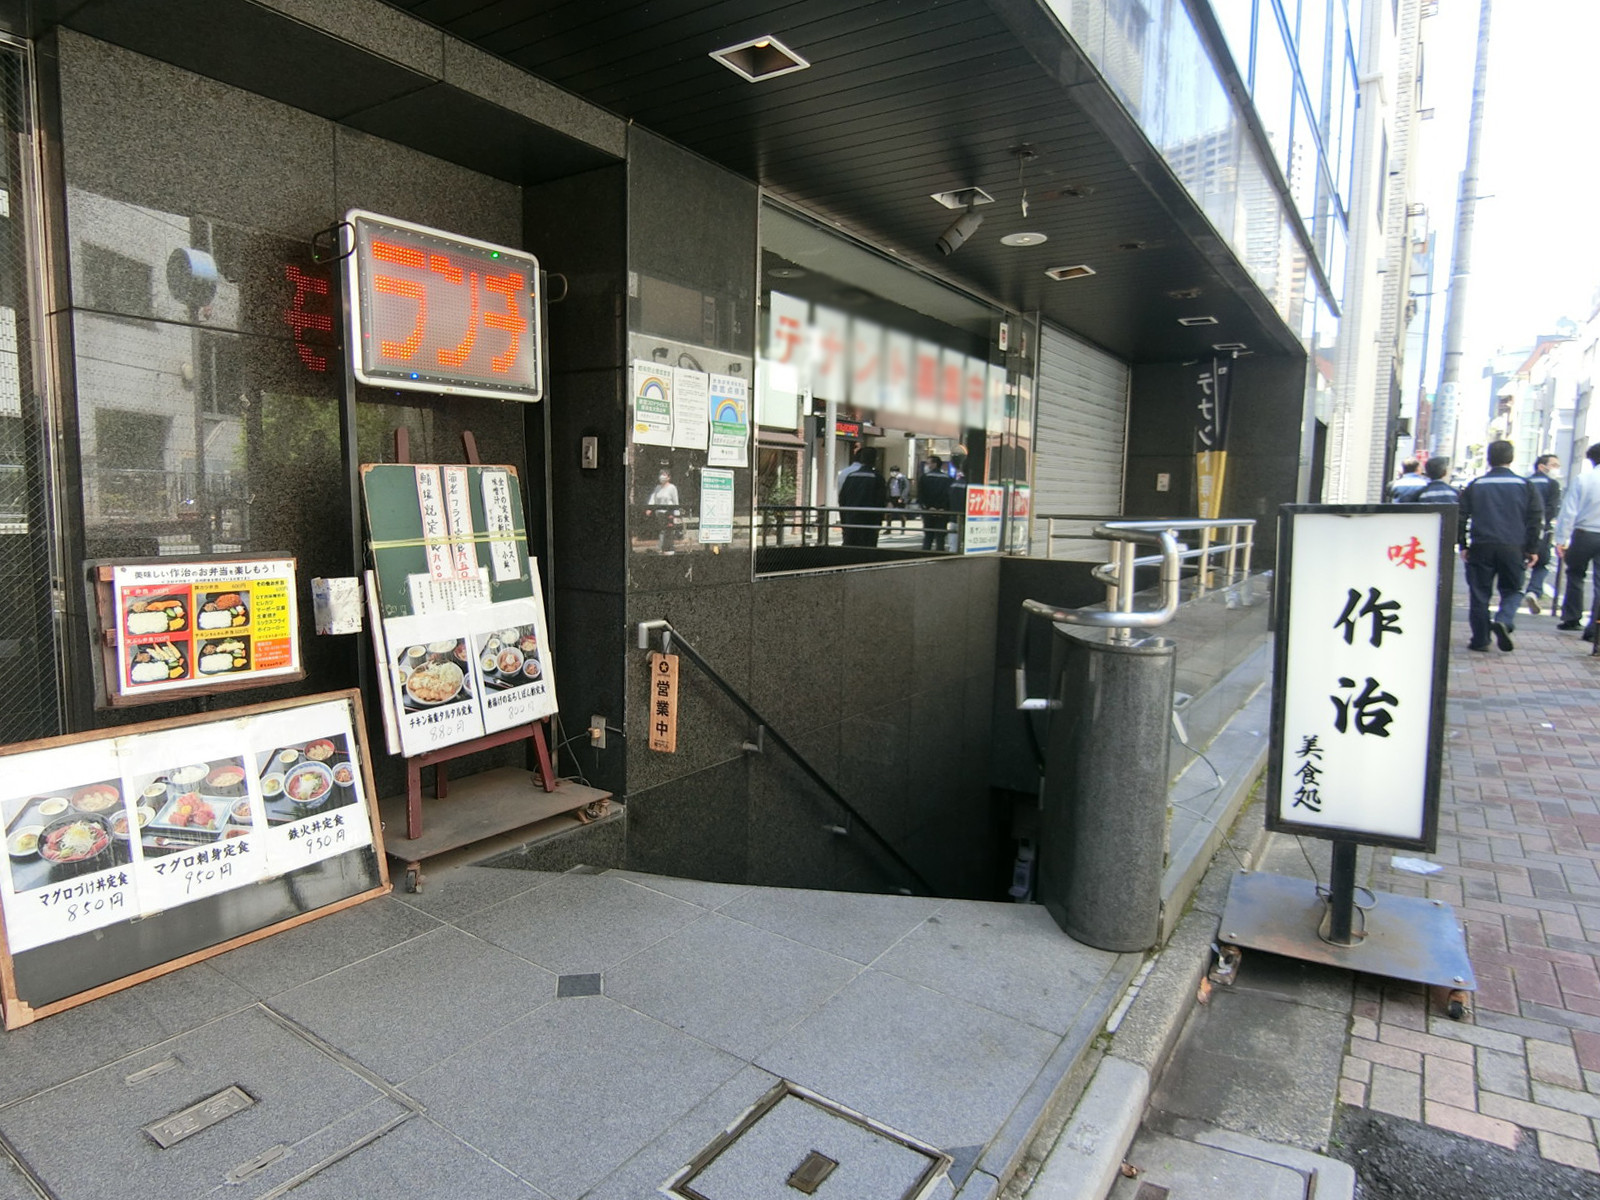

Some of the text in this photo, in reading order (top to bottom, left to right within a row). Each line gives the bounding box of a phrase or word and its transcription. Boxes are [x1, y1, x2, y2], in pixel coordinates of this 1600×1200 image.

[370, 240, 528, 374] ランチ
[1387, 535, 1427, 570] 味
[1329, 586, 1404, 738] 作治
[409, 704, 474, 729] チキン南蛮タルタル定食
[655, 680, 670, 737] 営業中
[429, 719, 466, 742] 880円
[1292, 734, 1325, 813] 美食処
[287, 814, 345, 842] 鉄火丼定食
[305, 829, 347, 855] 950円
[154, 840, 251, 877] マグロ刺身定食
[38, 871, 130, 908] マグロづけ丼定食
[184, 862, 233, 895] 950円
[67, 891, 124, 923] 850円
